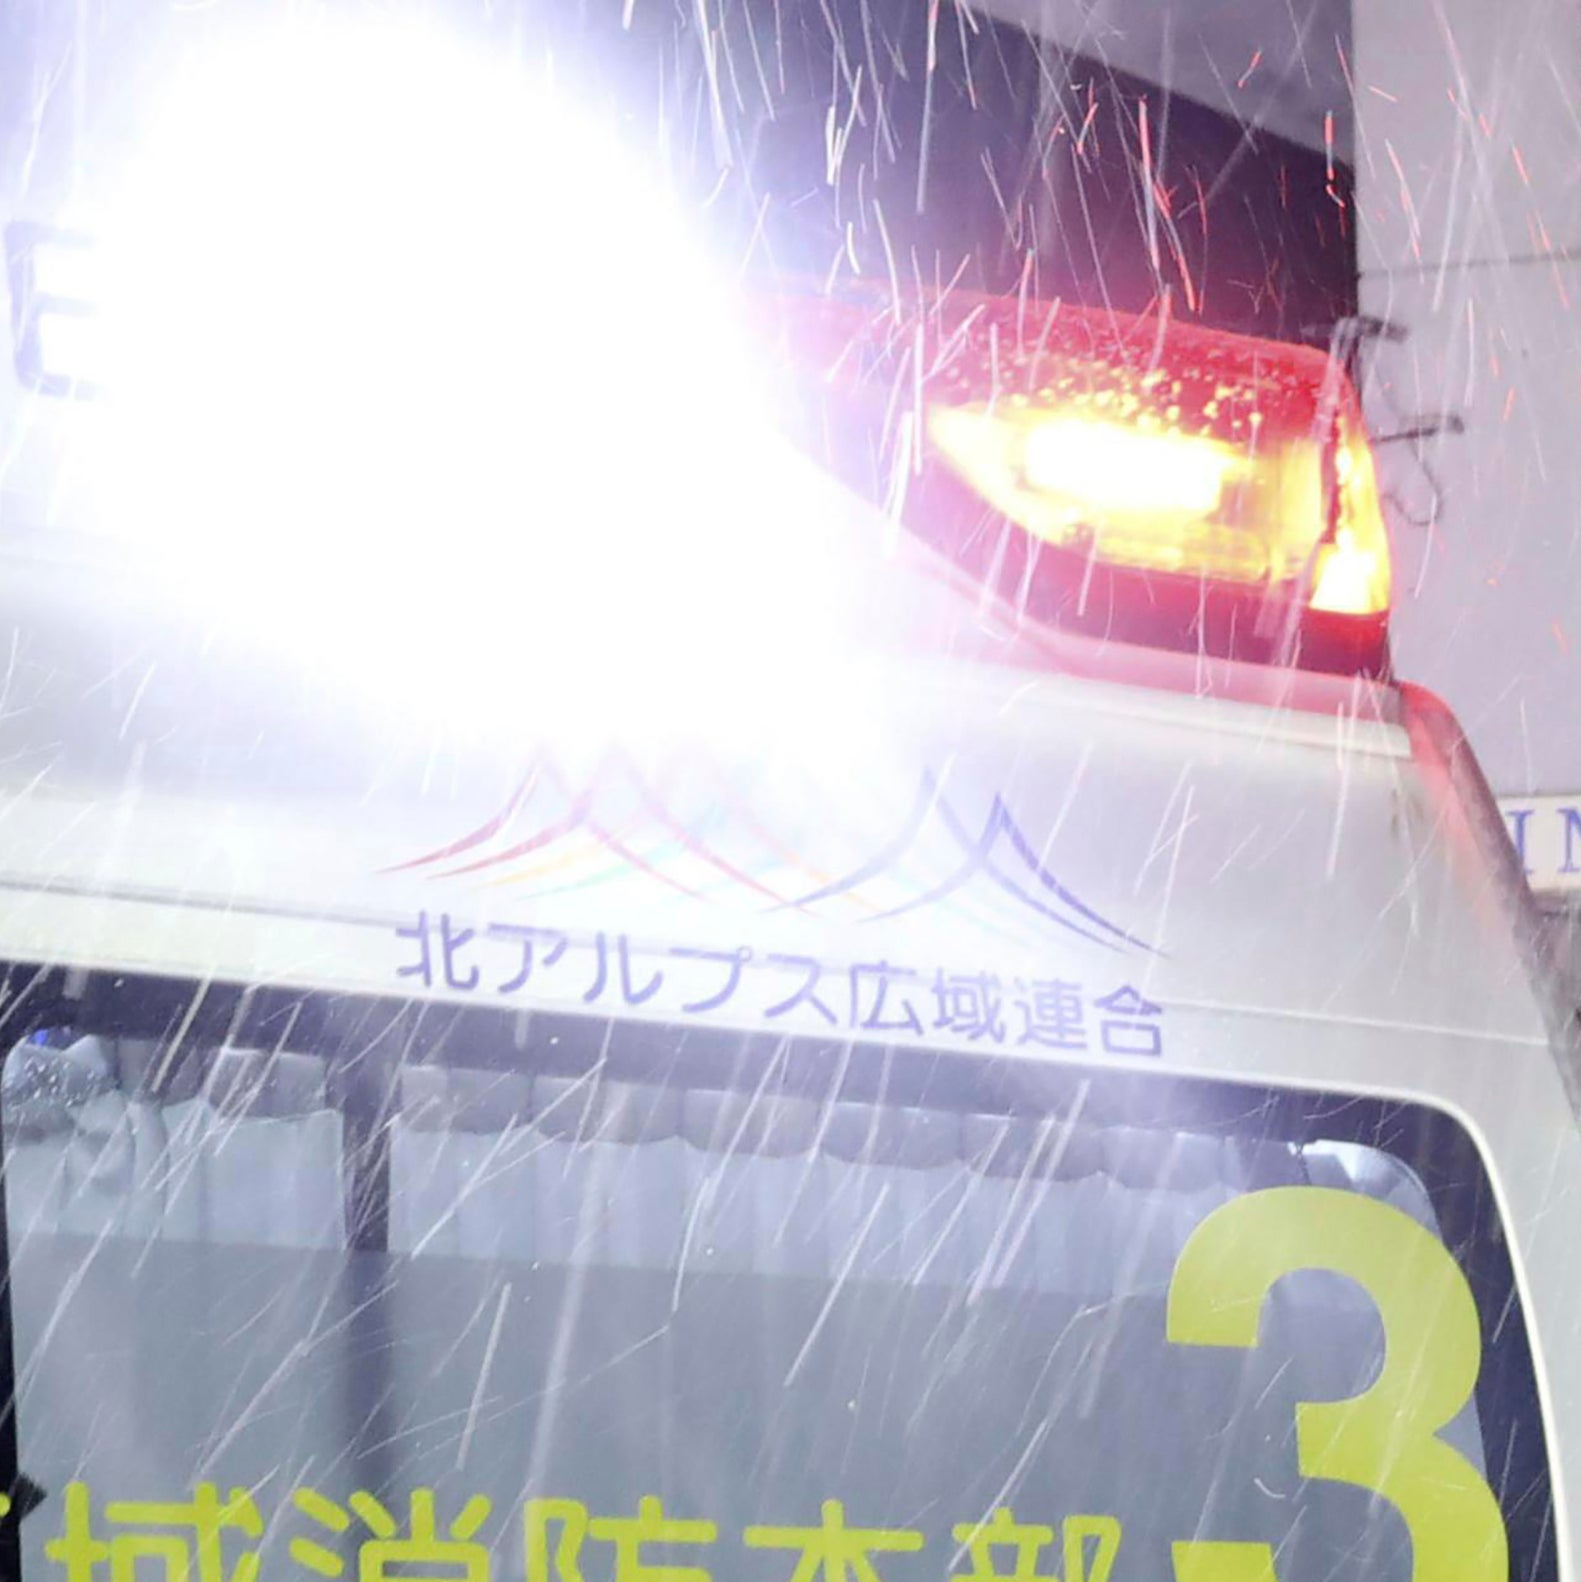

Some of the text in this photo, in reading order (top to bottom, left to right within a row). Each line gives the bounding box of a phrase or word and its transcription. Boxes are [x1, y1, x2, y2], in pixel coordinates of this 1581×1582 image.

[396, 909, 1164, 1058] 北アルプス広域連合
